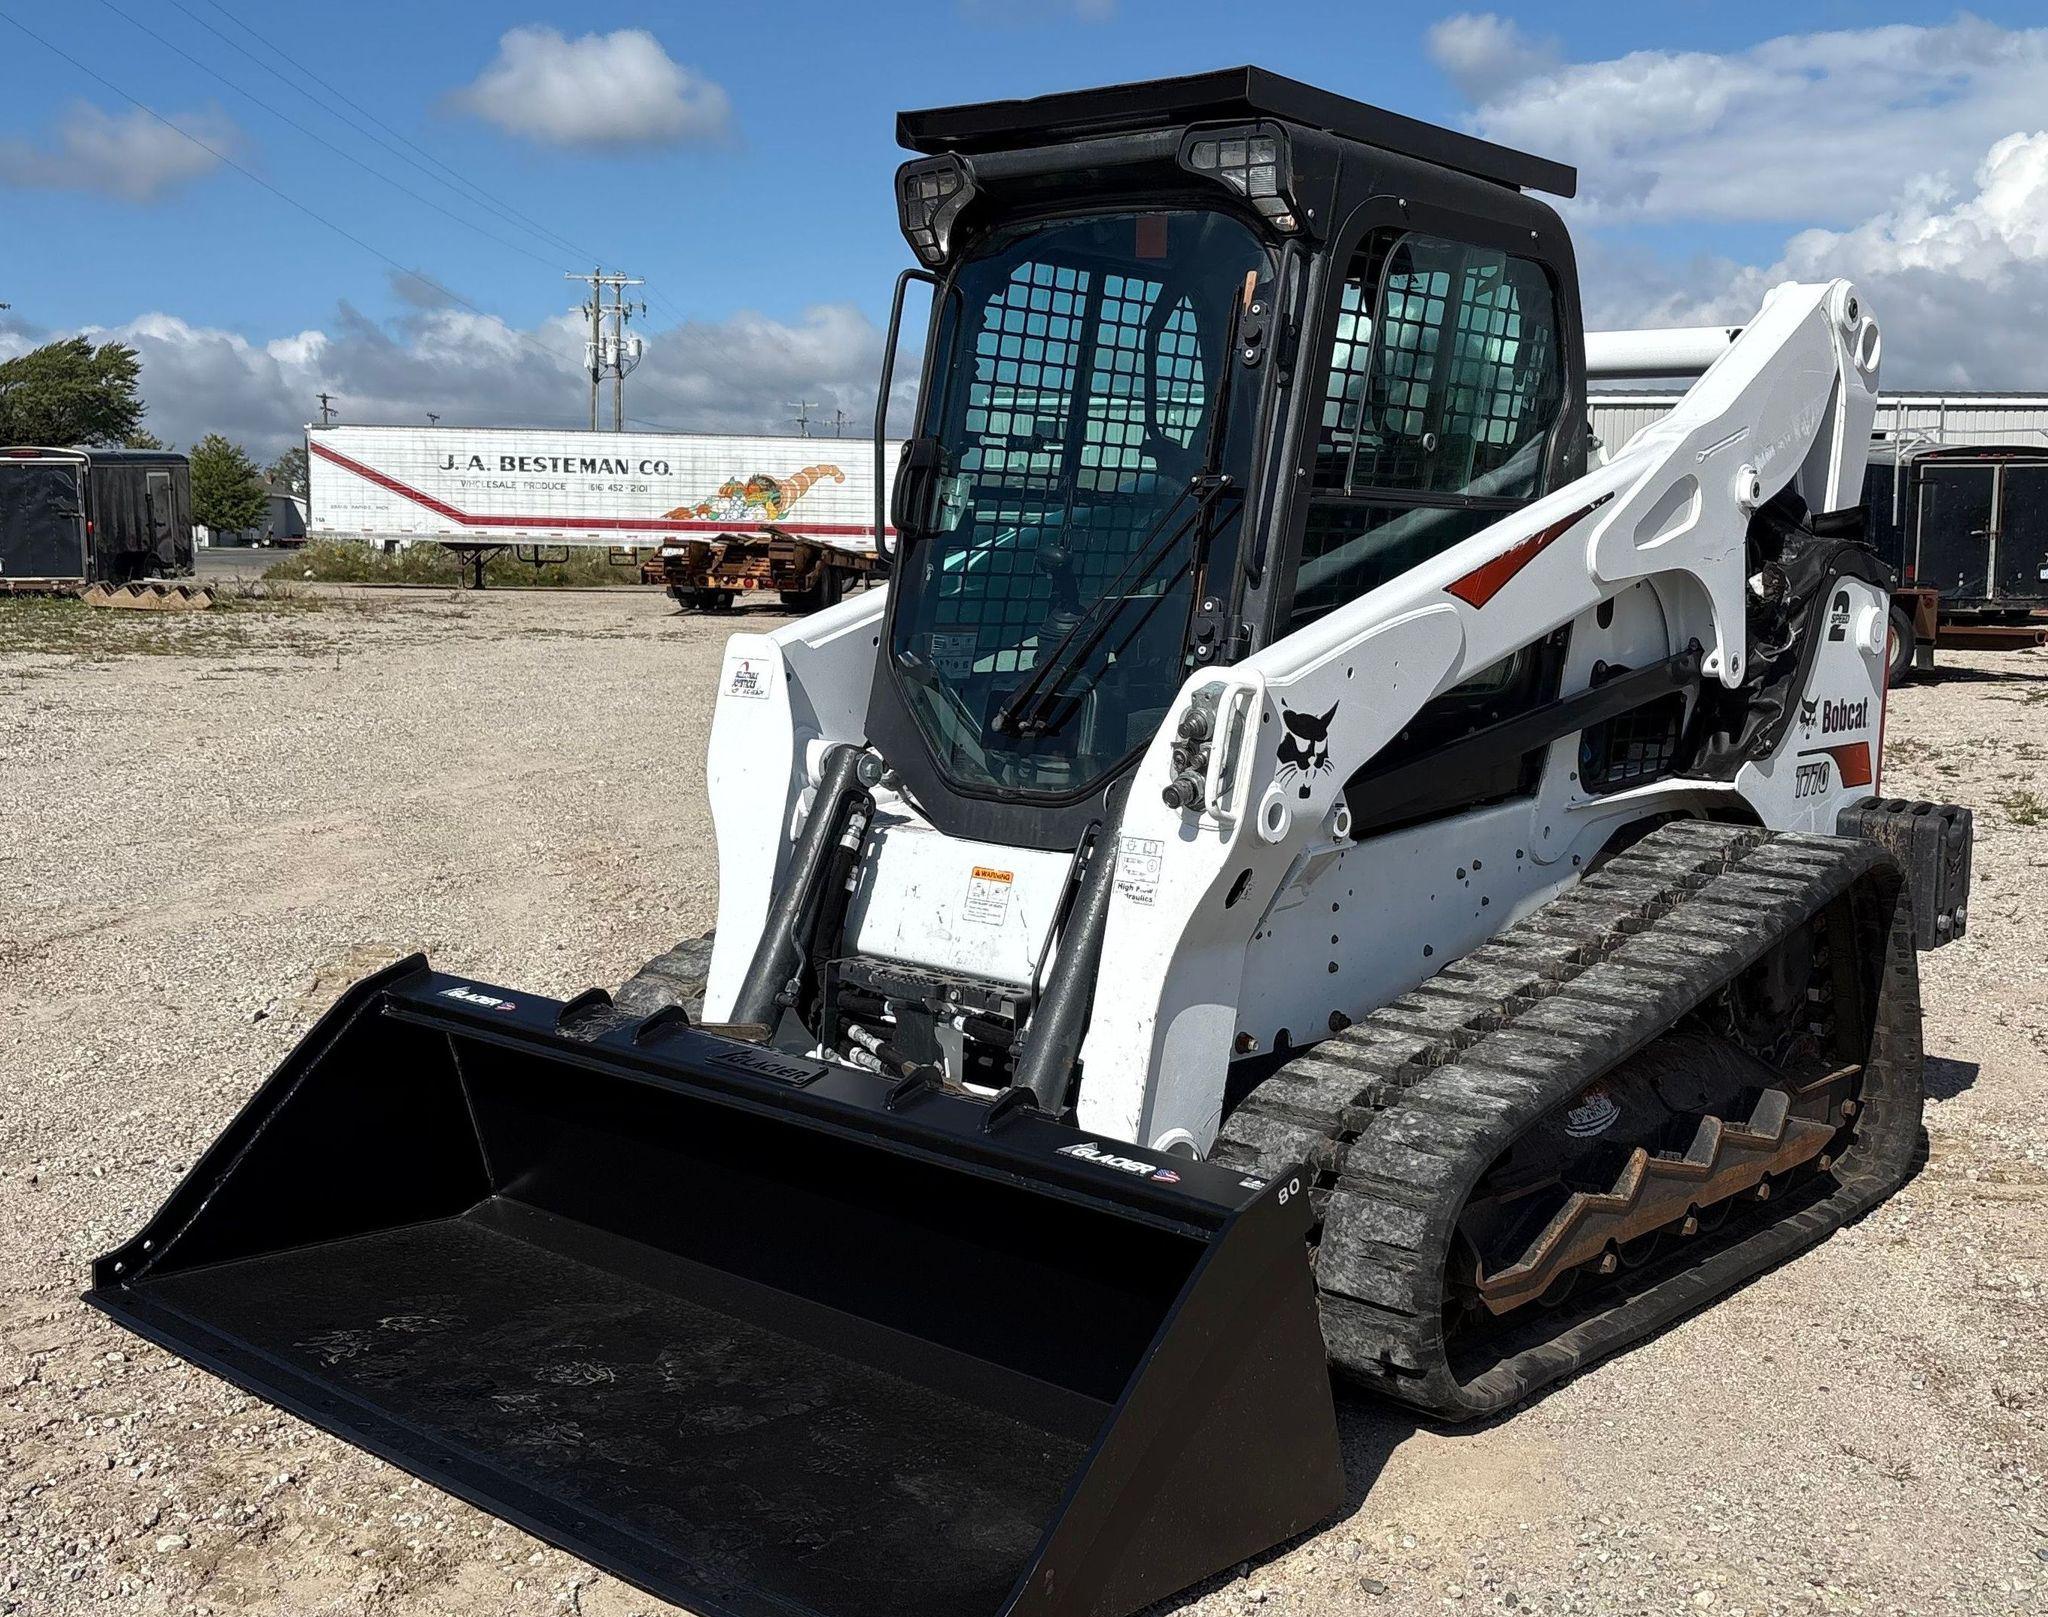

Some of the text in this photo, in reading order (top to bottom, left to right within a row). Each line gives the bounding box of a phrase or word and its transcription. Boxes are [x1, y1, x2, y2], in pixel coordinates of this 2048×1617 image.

[439, 454, 674, 476] J. A. BESTEMAN CO.
[460, 480, 516, 490] WHOLESALE
[523, 481, 567, 491] PRODUCE
[1828, 590, 1850, 642] 2
[1830, 613, 1850, 625] SPEED
[1822, 696, 1868, 734] Bobcat
[1795, 760, 1830, 798] T770
[981, 870, 1010, 881] WARNING
[1117, 883, 1134, 892] High
[727, 1054, 810, 1081] GLACIER
[1071, 1147, 1156, 1175] GLACIER
[1278, 1177, 1300, 1206] 80
